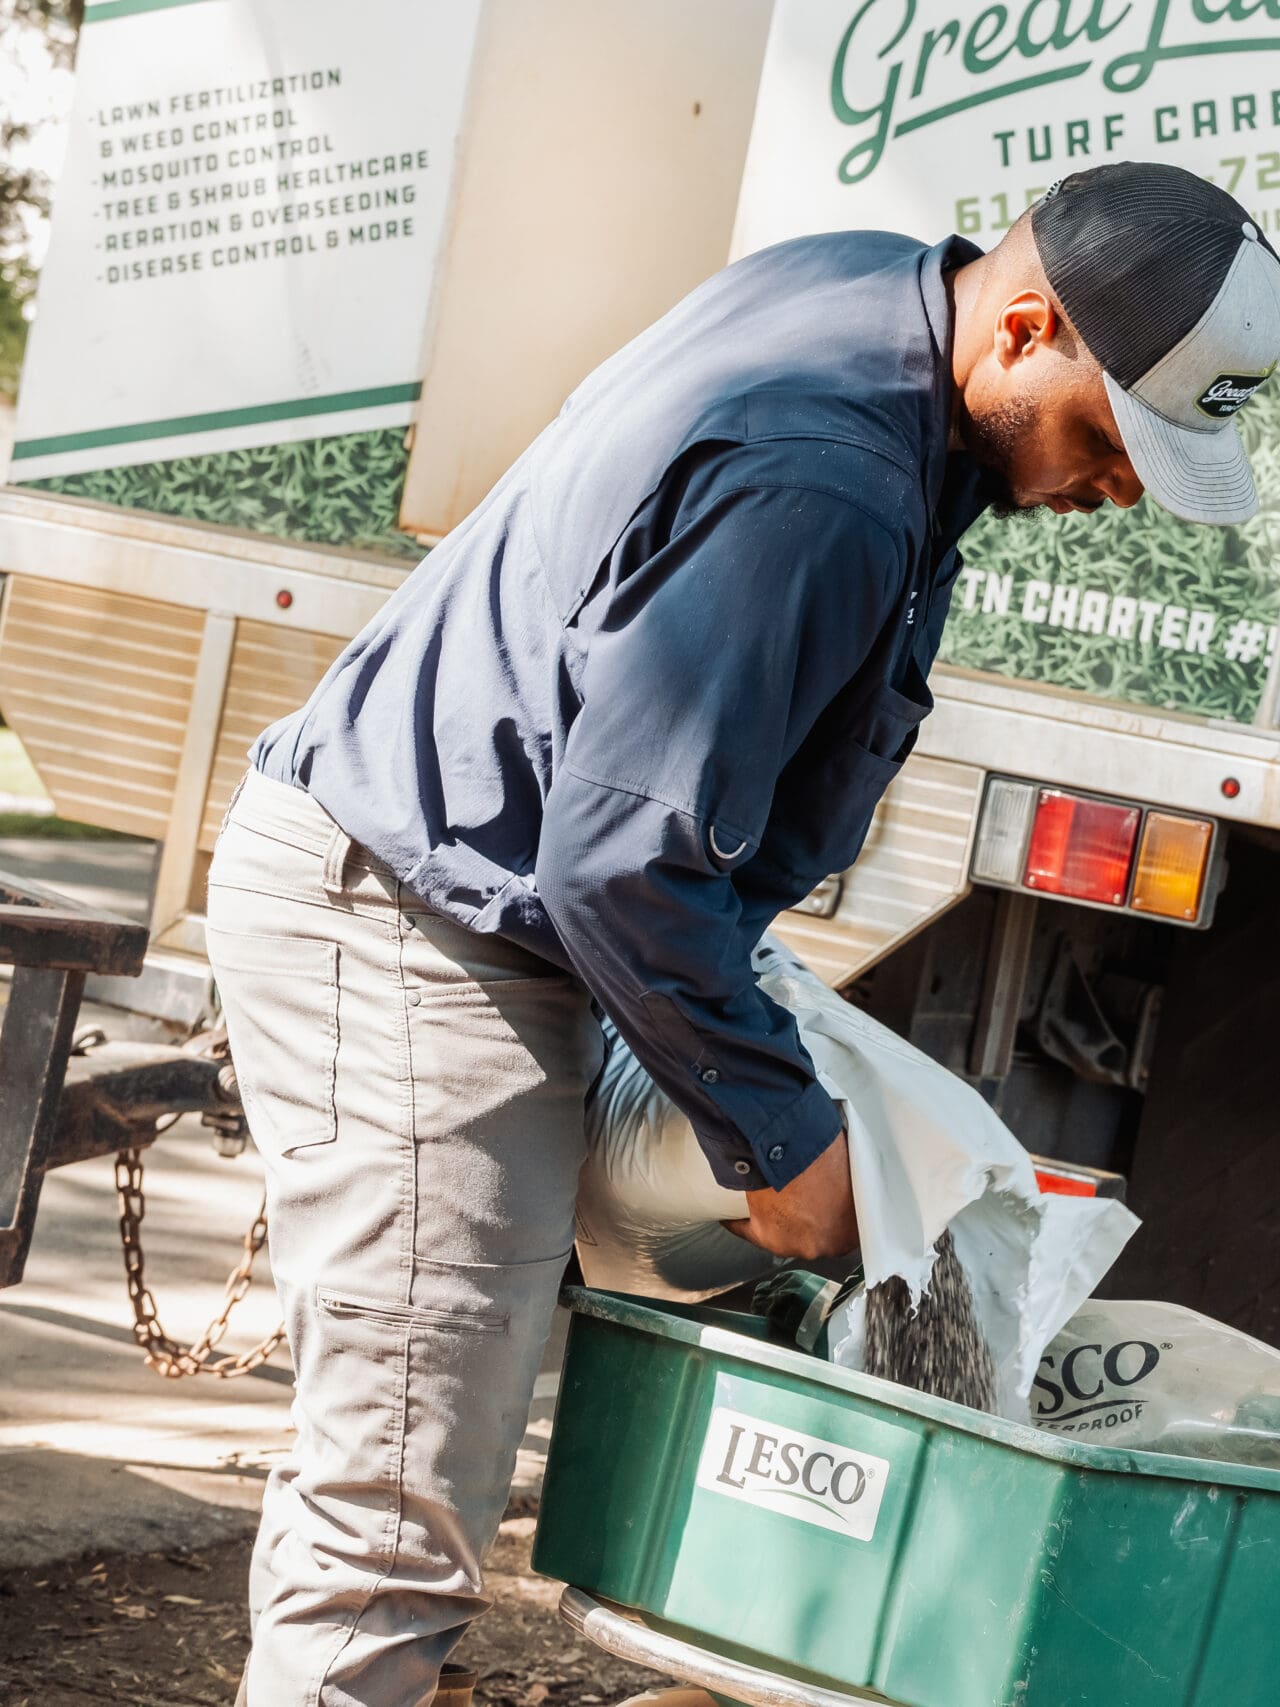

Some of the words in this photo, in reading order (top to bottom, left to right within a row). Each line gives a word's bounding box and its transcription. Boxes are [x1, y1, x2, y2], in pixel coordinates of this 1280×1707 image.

[170, 68, 341, 114] FERTILIZATION
[101, 140, 112, 158] &
[122, 128, 183, 153] WEED
[193, 109, 298, 142] CONTROL
[228, 135, 333, 168] CONTROL
[993, 114, 1124, 167] TURF
[168, 192, 180, 210] &
[189, 178, 266, 207] SHRUB
[277, 150, 429, 192] HEALTHCARE
[230, 214, 242, 232] &
[252, 185, 416, 228] OVERSEEDING
[212, 235, 317, 267] CONTROL
[326, 230, 338, 248] &
[349, 218, 414, 246] MORE
[962, 568, 1012, 616] TN
[1021, 580, 1217, 656] CHARTER
